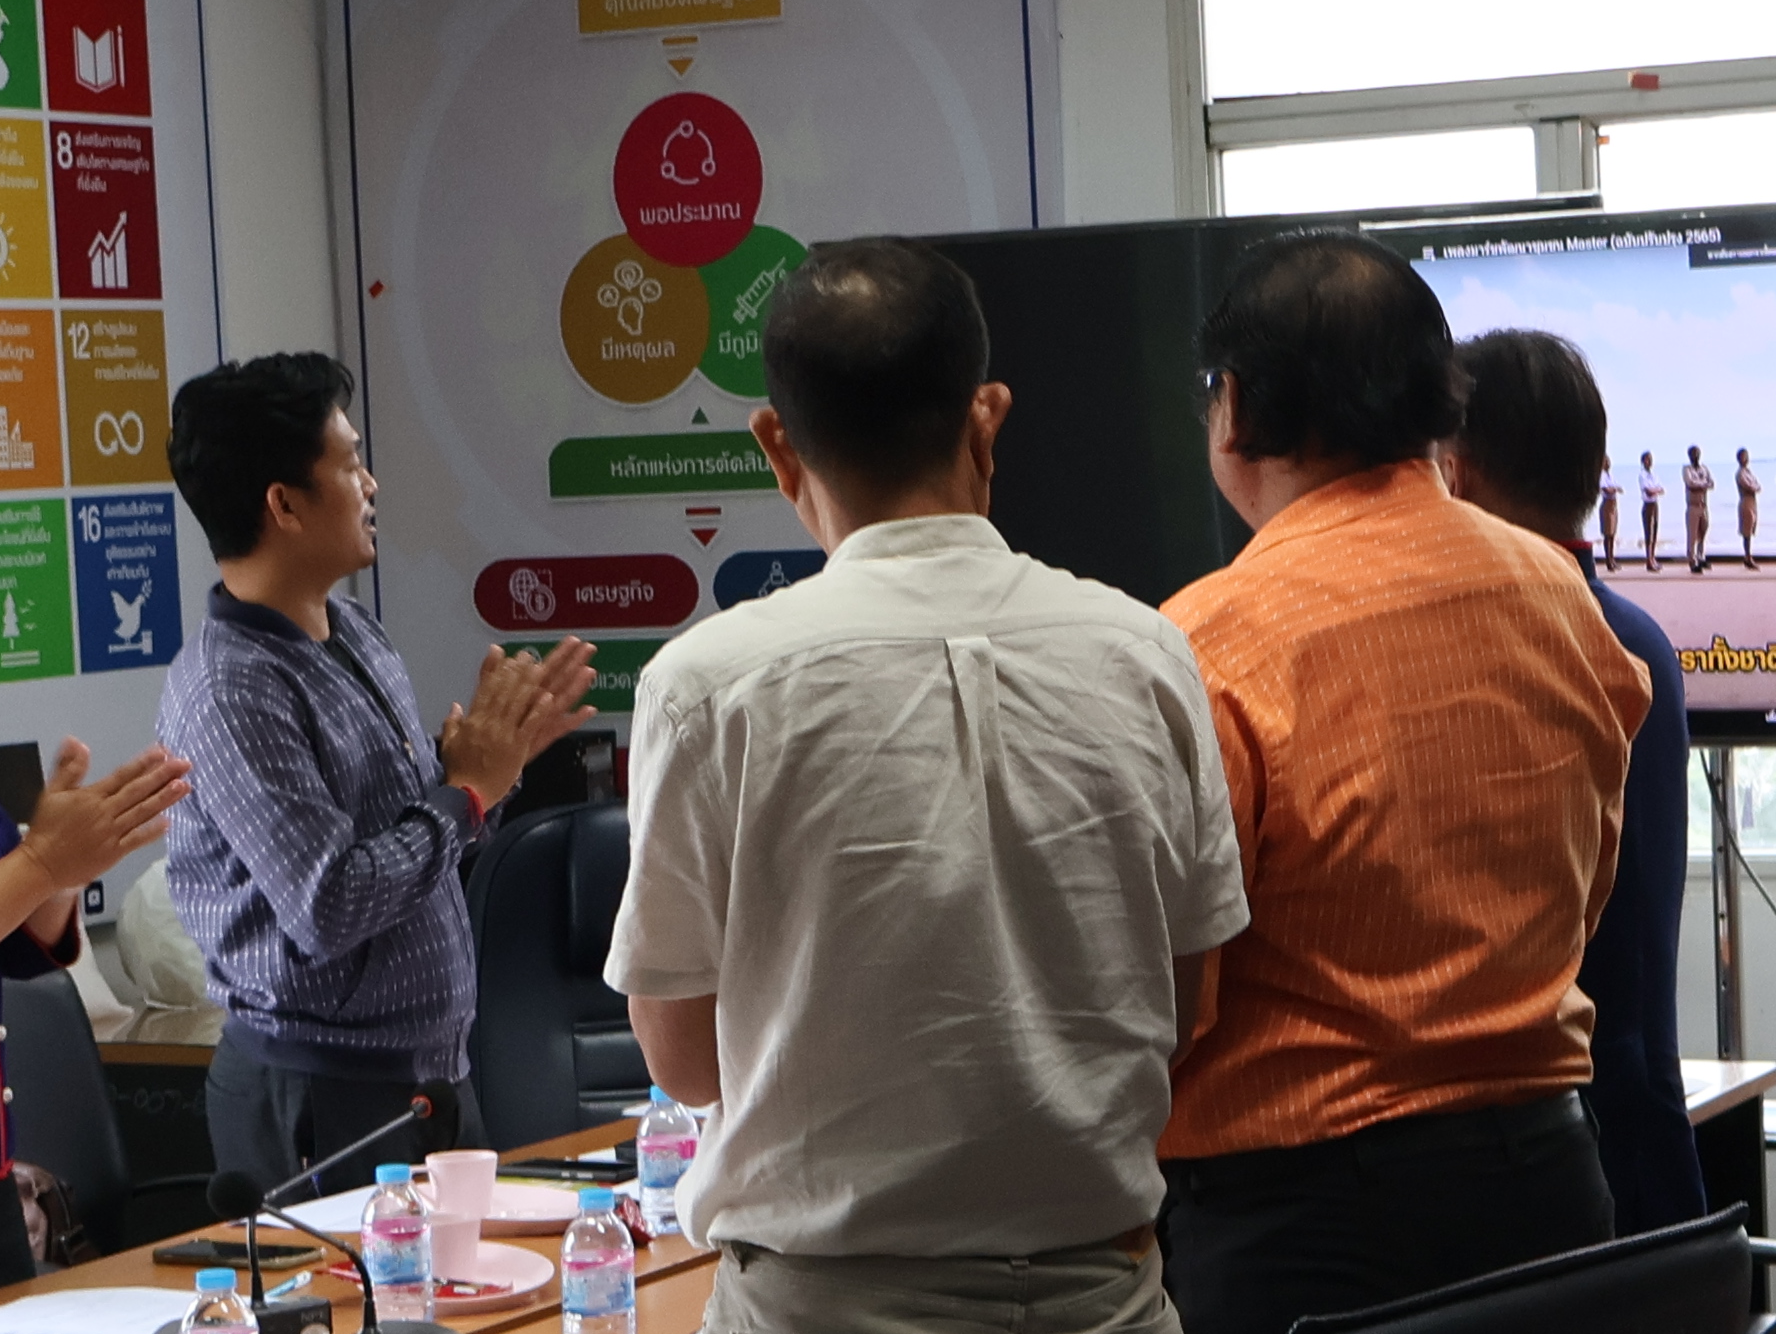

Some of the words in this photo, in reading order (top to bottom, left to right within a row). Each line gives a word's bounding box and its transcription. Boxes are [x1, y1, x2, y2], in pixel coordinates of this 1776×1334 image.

[56, 130, 74, 170] 8
[639, 200, 742, 225] พอประมาณ
[1566, 234, 1609, 252] Master
[1685, 226, 1722, 245] 2565)
[67, 320, 91, 360] 12
[600, 336, 677, 364] มีเหตุผล
[718, 330, 765, 360] มีภูมิ
[610, 451, 771, 478] หลักแห่งการตัดสิน
[77, 504, 102, 544] 16
[575, 580, 655, 607] เศรษฐกิจ
